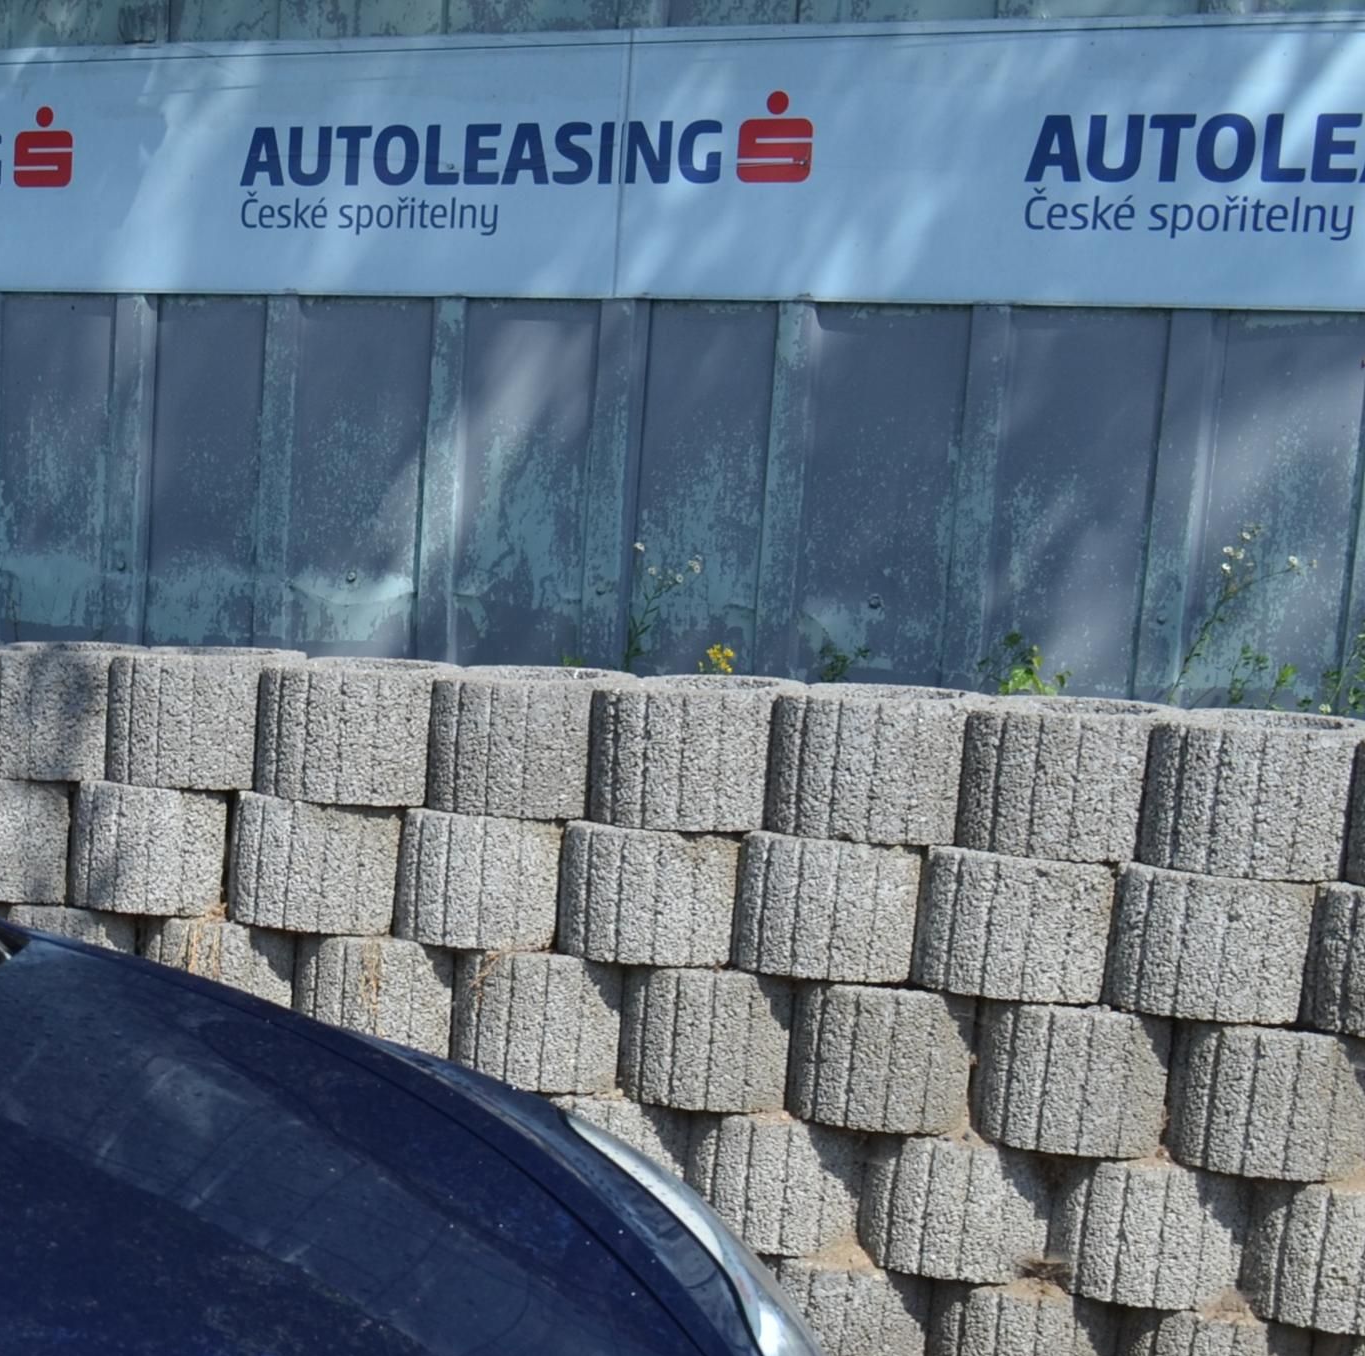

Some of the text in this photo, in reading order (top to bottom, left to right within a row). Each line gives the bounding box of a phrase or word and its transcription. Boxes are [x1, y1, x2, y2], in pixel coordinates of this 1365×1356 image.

[240, 119, 723, 186] AUTOLEASING
[1024, 112, 1365, 184] AUTOLE
[240, 190, 499, 237] České spořitelny
[1024, 187, 1355, 242] České spořitelny
